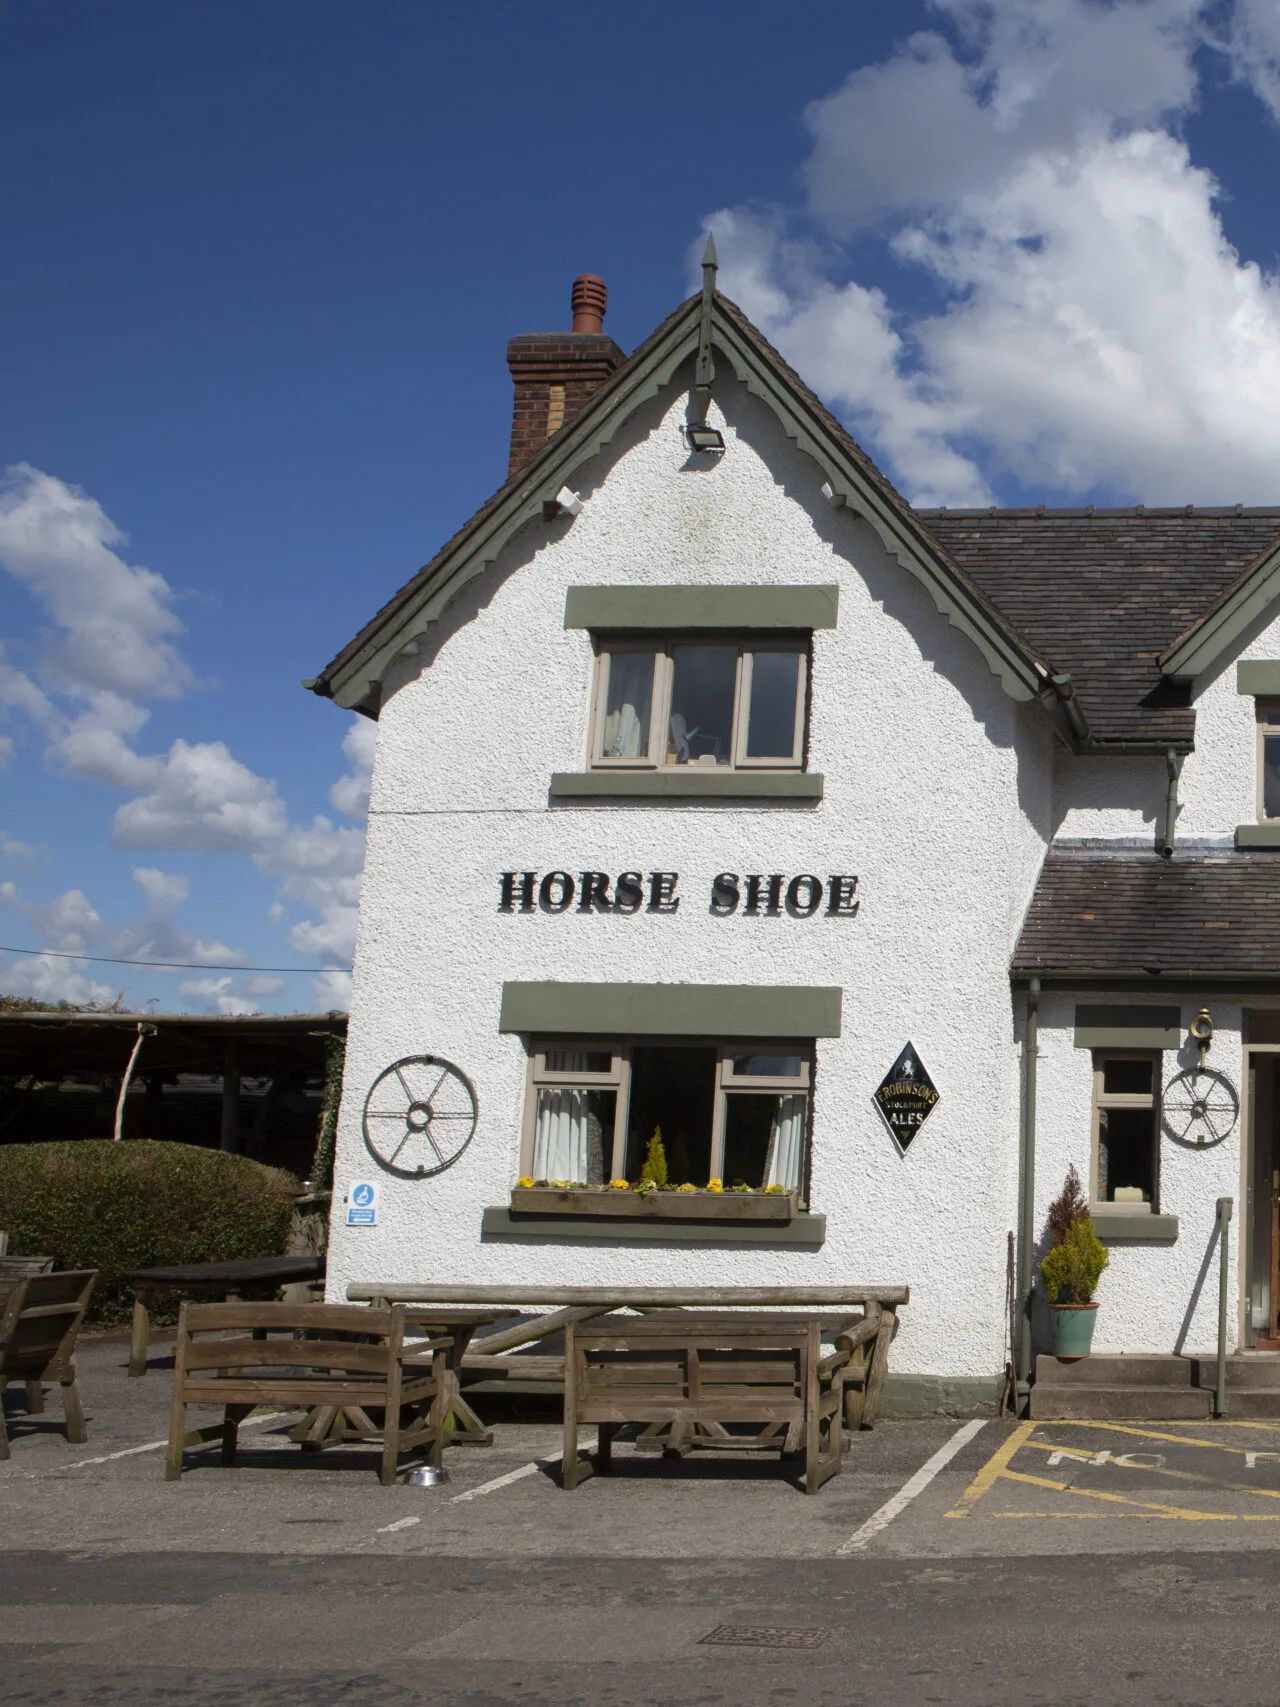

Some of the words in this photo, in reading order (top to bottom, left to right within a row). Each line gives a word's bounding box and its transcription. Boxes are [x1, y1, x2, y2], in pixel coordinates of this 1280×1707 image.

[499, 871, 681, 908] HORSE
[711, 872, 861, 910] SHOE
[890, 1112, 924, 1125] ALES
